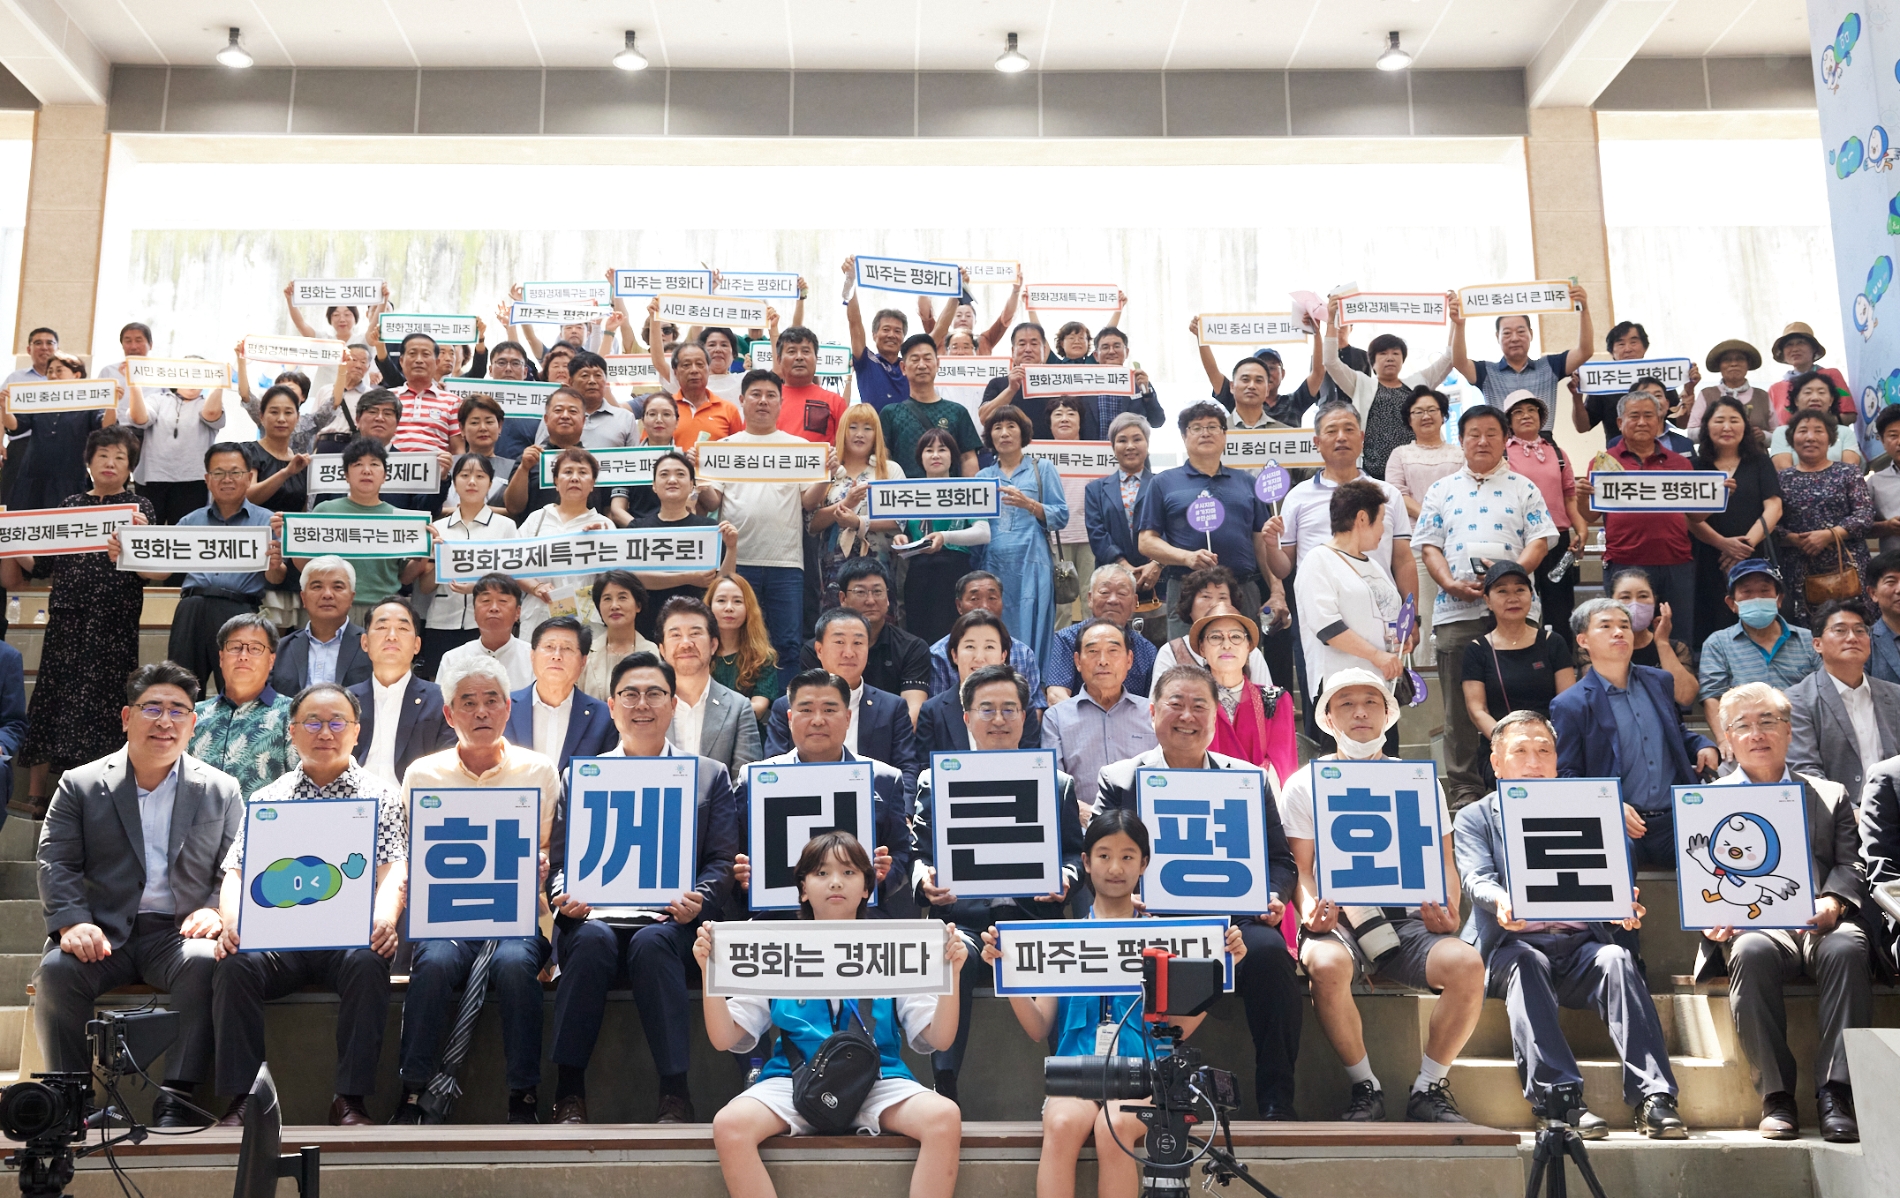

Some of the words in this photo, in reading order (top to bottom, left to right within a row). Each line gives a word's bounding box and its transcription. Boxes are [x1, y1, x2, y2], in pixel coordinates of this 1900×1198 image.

[866, 264, 907, 284] 파주는
[911, 268, 952, 287] 평화다
[965, 266, 972, 275] 심
[975, 266, 983, 275] 더
[985, 266, 994, 275] 큰
[997, 266, 1013, 275] 파주
[624, 276, 661, 290] 파주는
[665, 276, 704, 290] 평화다
[720, 279, 754, 291] 파주는
[757, 279, 792, 292] 평화다
[300, 286, 336, 299] 평화는
[341, 286, 377, 299] 경제다
[529, 288, 587, 299] 평화경제특구는
[589, 288, 605, 298] 파주
[1031, 291, 1096, 303] 평화경제특구는
[1099, 292, 1117, 303] 파주
[1467, 293, 1489, 306] 시민
[1491, 292, 1513, 305] 중심
[1516, 291, 1527, 303] 더
[1530, 291, 1541, 303] 큰
[1544, 289, 1566, 302] 파주
[519, 308, 559, 320] 파주는
[663, 304, 685, 316] 시민
[688, 306, 710, 318] 중심
[713, 307, 724, 318] 더
[726, 307, 737, 319] 큰
[740, 308, 762, 320] 파주
[1345, 302, 1421, 315] 평화경제특구는
[1424, 303, 1443, 314] 파주
[386, 322, 450, 334] 평화경제특구는
[453, 323, 471, 334] 파주
[1207, 323, 1227, 334] 시민
[1230, 323, 1250, 334] 중심
[1254, 323, 1264, 334] 더
[1267, 322, 1277, 334] 큰
[248, 343, 319, 359] 평화경제특구는
[321, 350, 341, 360] 파주
[825, 355, 844, 366] 파주
[133, 365, 154, 377] 시민
[156, 365, 177, 378] 중심
[179, 366, 189, 378] 더
[192, 366, 202, 378] 큰
[204, 366, 225, 379] 파주
[607, 365, 657, 376] 평화경제특
[937, 366, 986, 377] 경제특구는
[989, 366, 1008, 378] 파주
[1587, 369, 1632, 385] 파주는
[1029, 373, 1105, 386] 평화경제특구는
[1107, 373, 1129, 385] 파주
[15, 392, 36, 403] 시민
[39, 391, 60, 403] 중심
[63, 390, 73, 402] 더
[76, 390, 86, 401] 큰
[89, 388, 111, 400] 파주
[1223, 442, 1238, 456] 민
[1242, 441, 1266, 455] 중심
[1270, 441, 1281, 454] 더
[1284, 441, 1296, 454] 큰
[704, 455, 730, 469] 시민
[733, 455, 759, 469] 중심
[763, 455, 775, 469] 더
[779, 455, 791, 469] 큰
[795, 455, 820, 469] 파주
[1096, 454, 1119, 467] 파주
[879, 489, 932, 508] 파주는
[936, 487, 989, 507] 평화다
[1602, 481, 1656, 500] 파주는
[1662, 481, 1717, 501] 평화다
[0, 523, 98, 543] 평화경제특구는
[293, 527, 389, 544] 평화경제특구는
[392, 529, 419, 544] 파주
[131, 538, 192, 560] 평화는
[197, 538, 258, 560] 경제다
[452, 539, 618, 573] 평화경제특구는
[626, 537, 703, 562] 파주로!
[947, 779, 1045, 882] 큰
[578, 787, 683, 890] 께
[1327, 788, 1434, 890] 화
[1154, 799, 1253, 898] 평
[1521, 817, 1615, 903] 로
[424, 817, 531, 924] 함
[728, 940, 825, 979] 평화는
[834, 940, 930, 978] 경제다
[1016, 938, 1108, 975] 파주는
